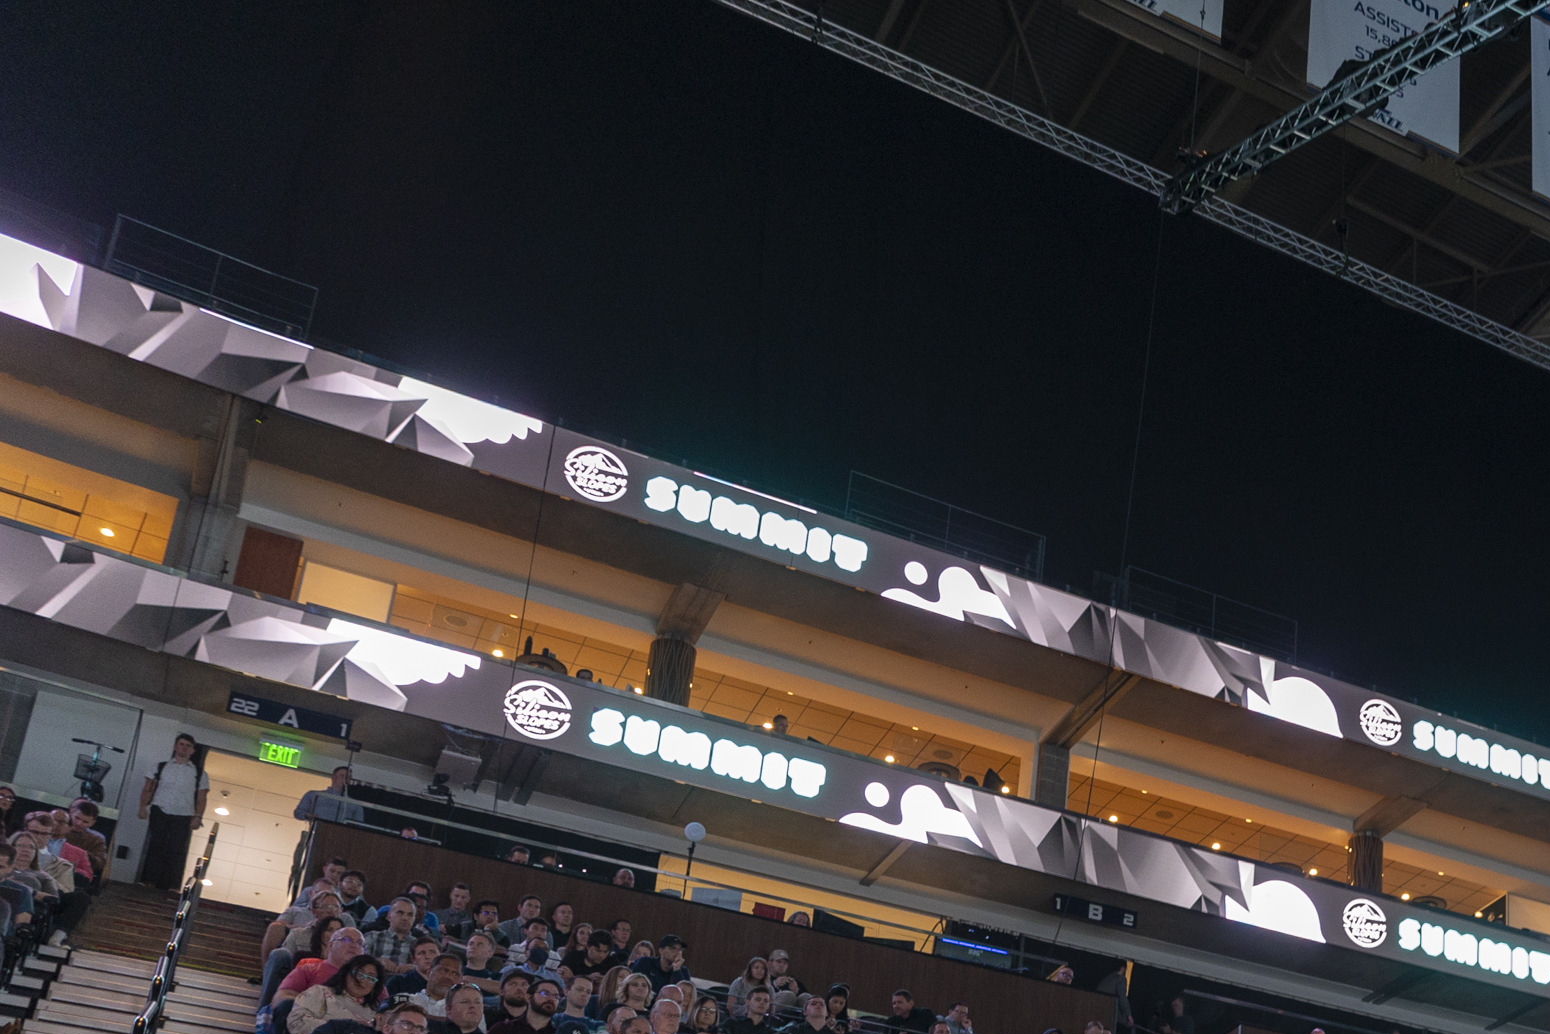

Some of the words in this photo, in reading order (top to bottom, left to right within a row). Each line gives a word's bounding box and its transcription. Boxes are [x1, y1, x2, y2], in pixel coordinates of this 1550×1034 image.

[644, 476, 868, 573] SUMMIT
[229, 697, 260, 717] 22
[278, 708, 299, 729] A
[340, 723, 348, 737] 1
[267, 747, 295, 765] EXIT
[589, 708, 827, 798] SUMMIT
[1055, 897, 1061, 910] 1
[1088, 903, 1103, 921] B
[1123, 913, 1135, 926] 2
